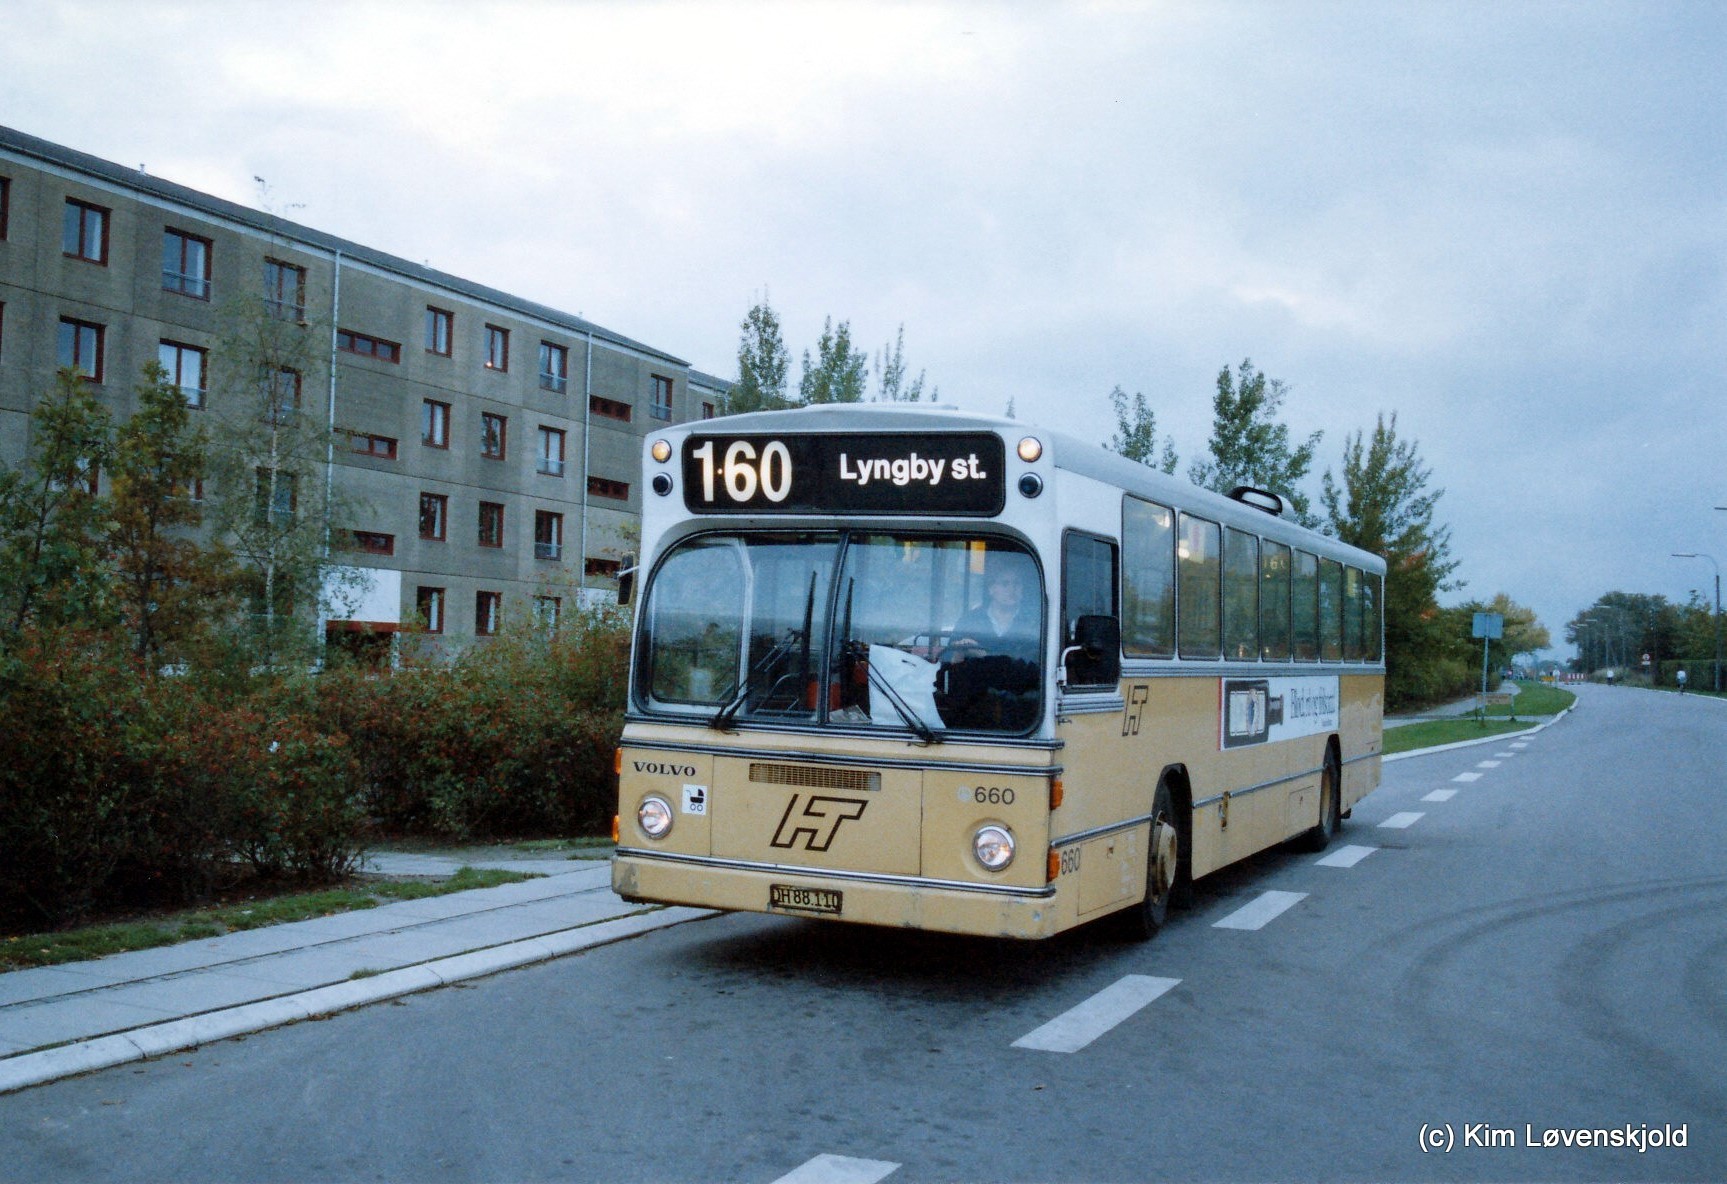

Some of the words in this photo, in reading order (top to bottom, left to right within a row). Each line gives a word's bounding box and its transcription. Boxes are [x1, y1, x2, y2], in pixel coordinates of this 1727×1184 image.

[693, 440, 792, 502] 160
[839, 453, 945, 485] Lyngby
[951, 454, 987, 480] st.
[633, 761, 696, 777] VOLVO
[974, 786, 1015, 805] 660
[1061, 847, 1081, 876] 660
